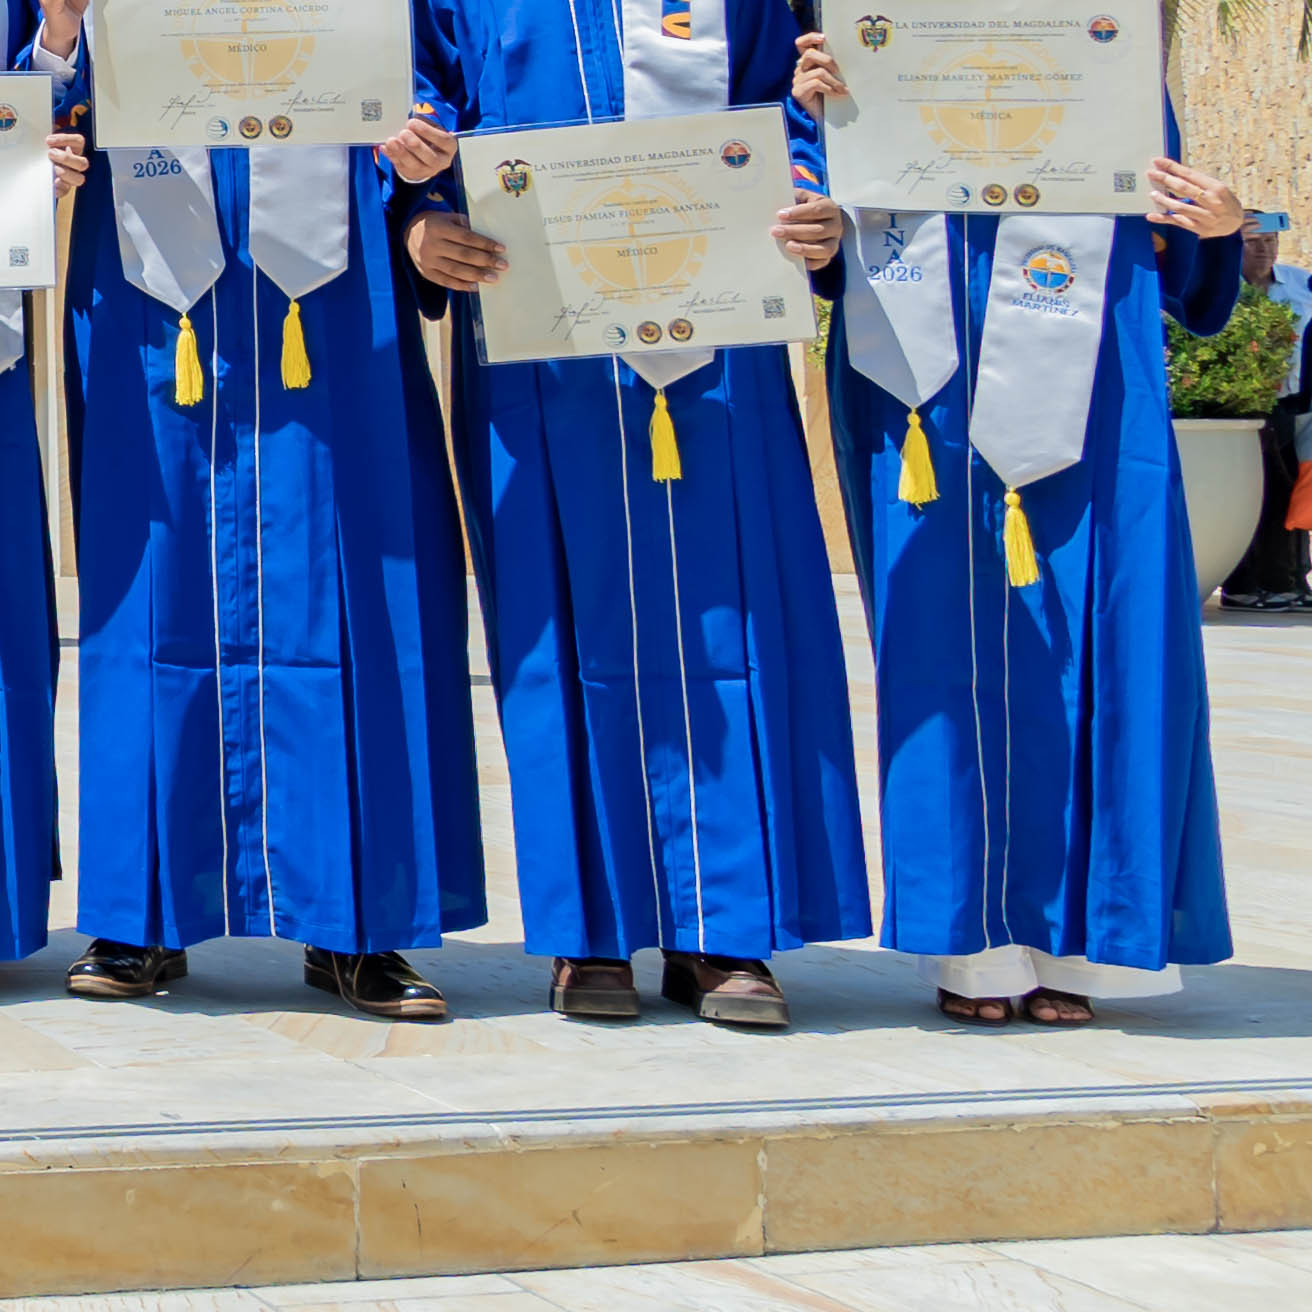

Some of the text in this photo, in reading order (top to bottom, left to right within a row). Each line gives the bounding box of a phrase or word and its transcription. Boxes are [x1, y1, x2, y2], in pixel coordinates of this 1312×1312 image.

[164, 8, 202, 16] MIGUEL
[240, 6, 284, 14] CORTINA
[287, 5, 328, 13] CAICEDO
[912, 21, 986, 30] UNIVERSIDAD
[990, 20, 1010, 28] DEL
[1014, 20, 1080, 28] MAGDALENA
[534, 148, 714, 172] LA UNIVERSIDAD DEL MAGDALENA
[134, 159, 182, 178] 2026
[619, 208, 670, 218] FIGUEROA
[674, 202, 720, 212] SANTANA
[868, 265, 922, 282] 2026
